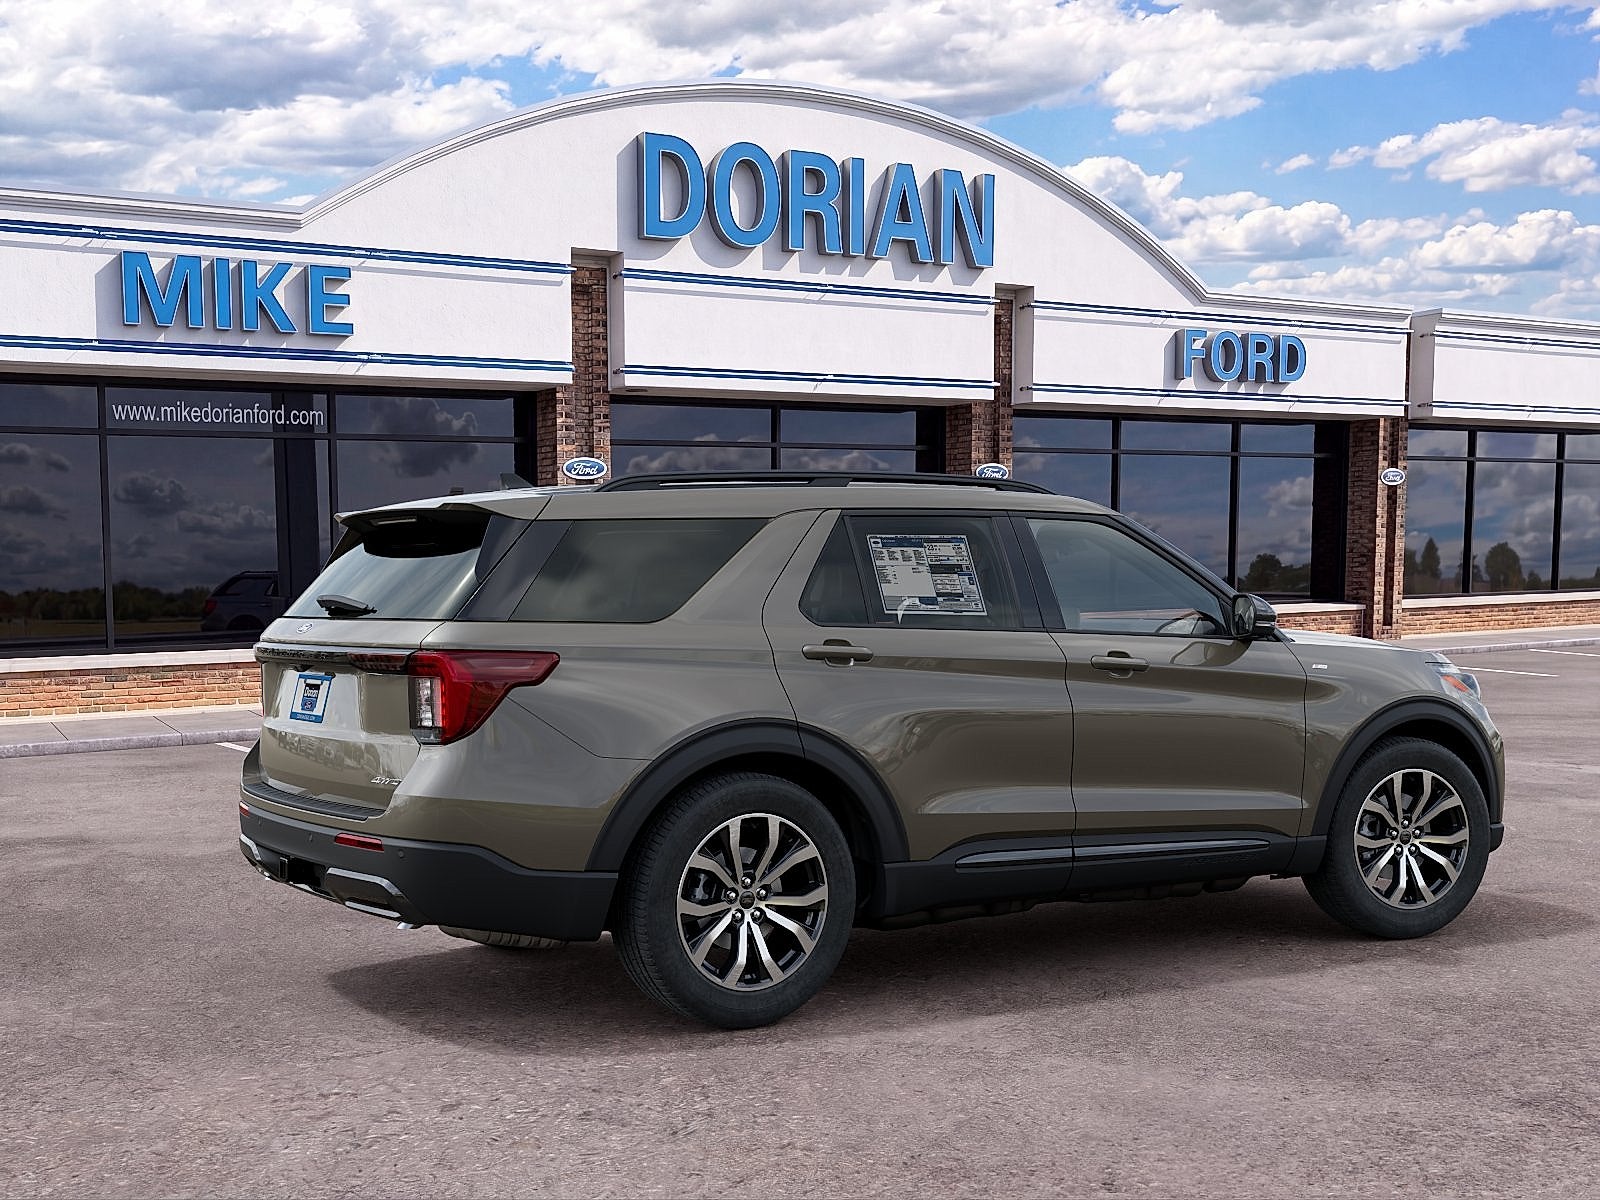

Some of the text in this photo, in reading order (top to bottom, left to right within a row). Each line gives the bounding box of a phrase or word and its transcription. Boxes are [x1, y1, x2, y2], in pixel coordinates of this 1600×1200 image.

[639, 131, 996, 268] DORIAN
[121, 250, 354, 336] MIKE
[1175, 328, 1307, 383] FORD
[112, 401, 324, 426] www.mikedorianford.com
[571, 462, 599, 475] Ford
